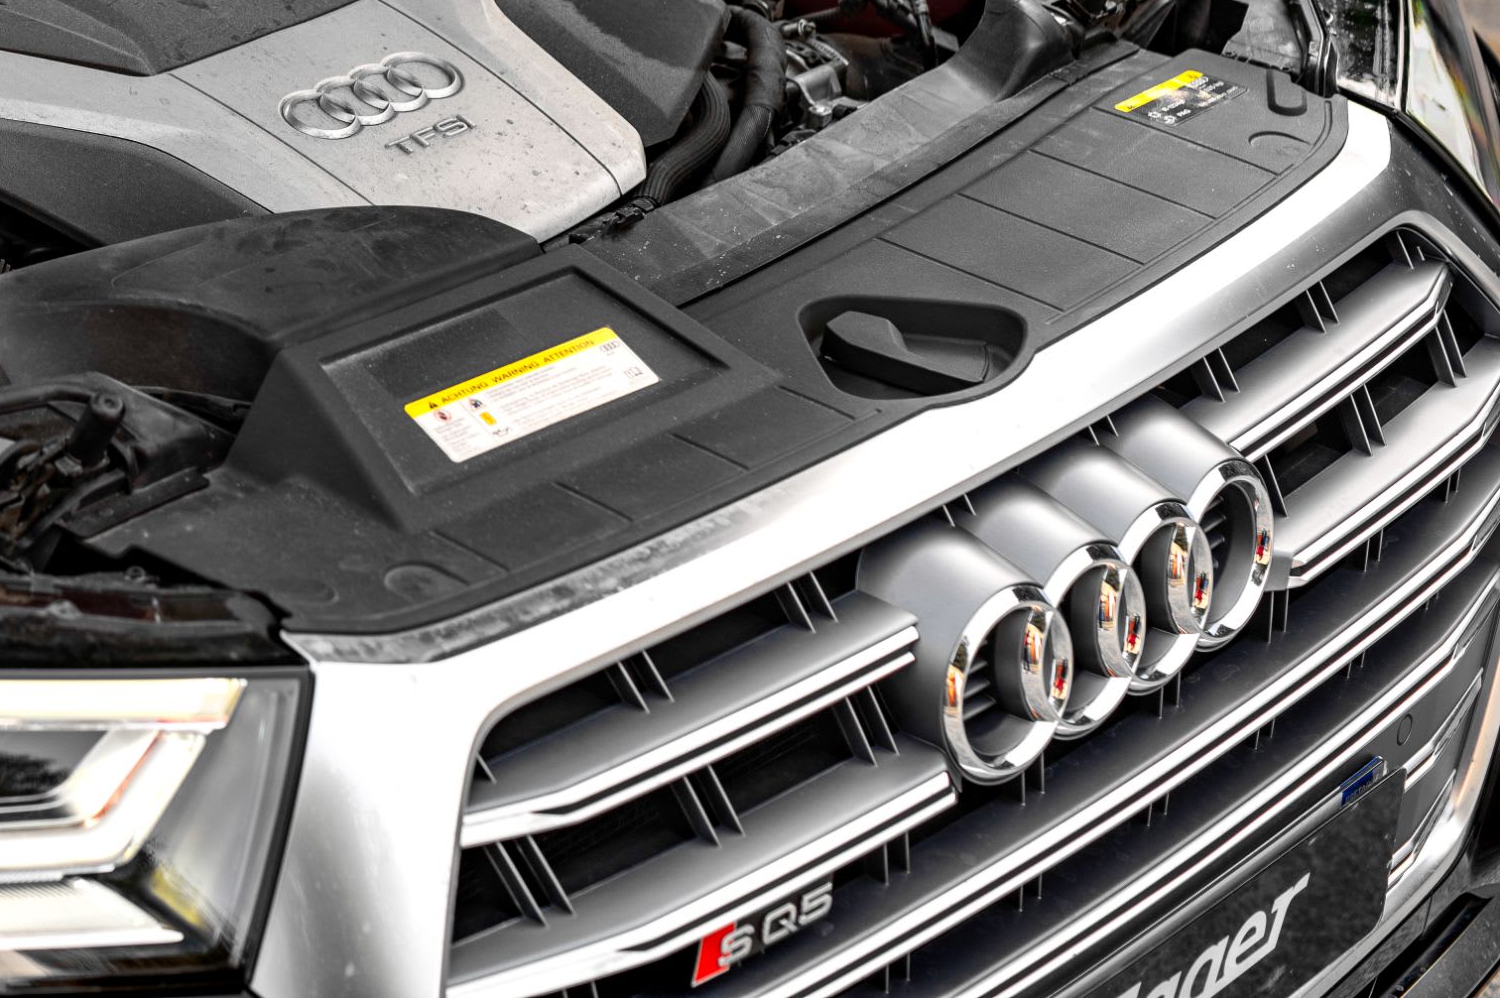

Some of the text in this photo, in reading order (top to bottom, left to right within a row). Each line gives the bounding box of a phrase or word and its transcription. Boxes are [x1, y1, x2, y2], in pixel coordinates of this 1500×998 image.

[384, 114, 476, 154] TFSI
[441, 339, 595, 404] ACHTUNG WARNING ATTENTION
